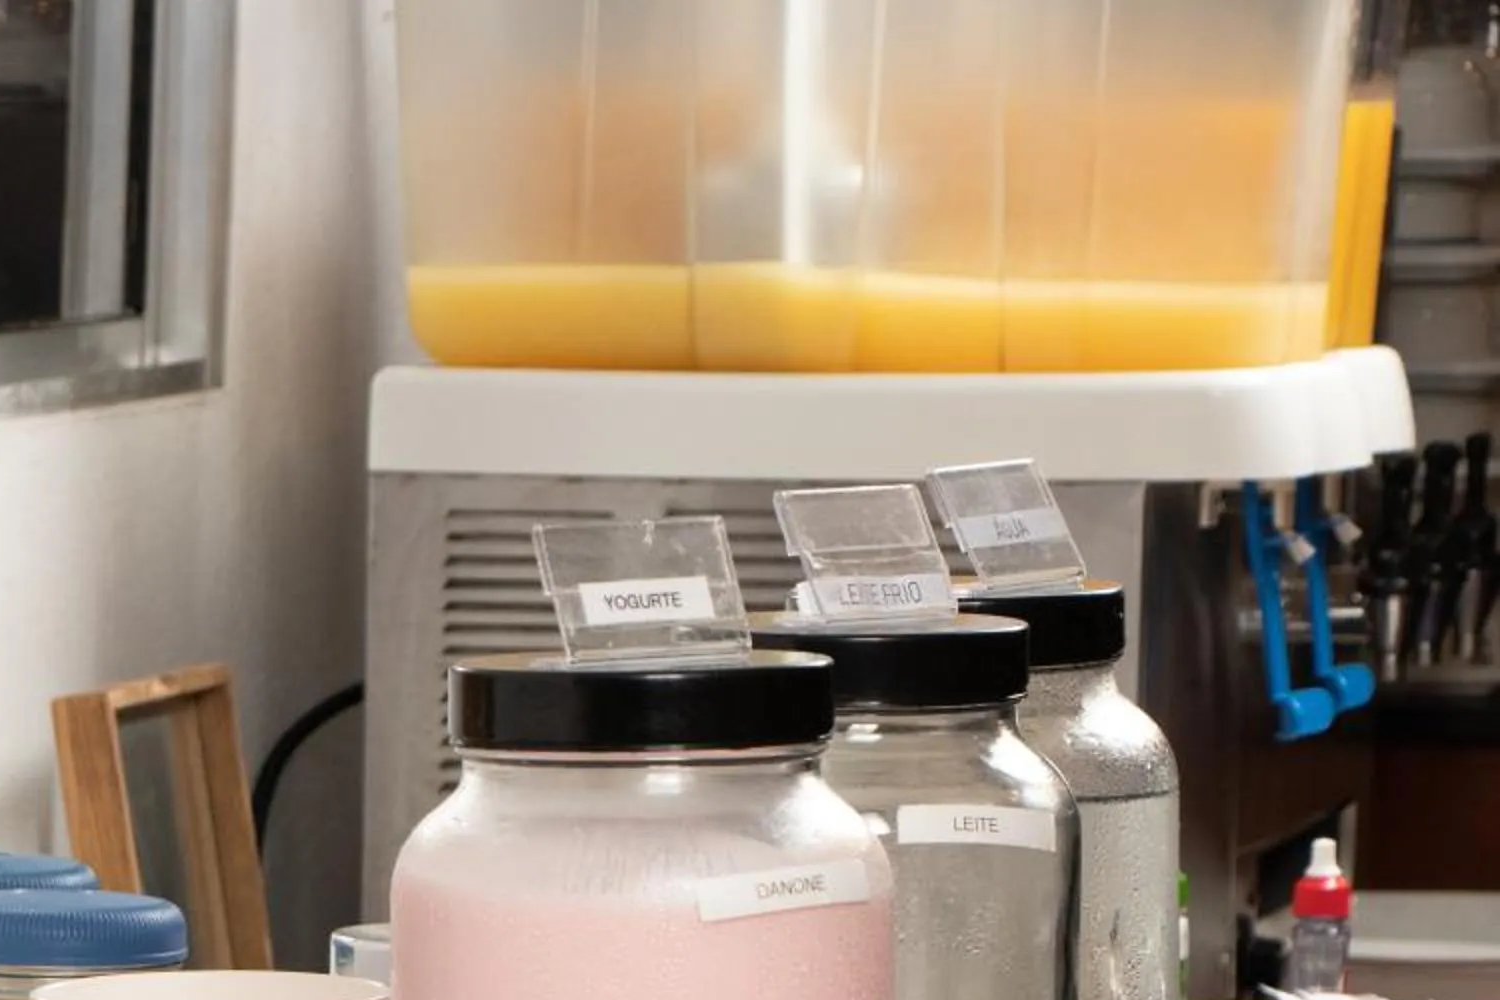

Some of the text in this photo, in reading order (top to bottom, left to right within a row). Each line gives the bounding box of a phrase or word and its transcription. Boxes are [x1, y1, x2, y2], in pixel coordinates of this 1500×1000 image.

[603, 591, 683, 610] YOGURTE
[953, 816, 999, 833] LEITE
[757, 874, 826, 899] DANONE
